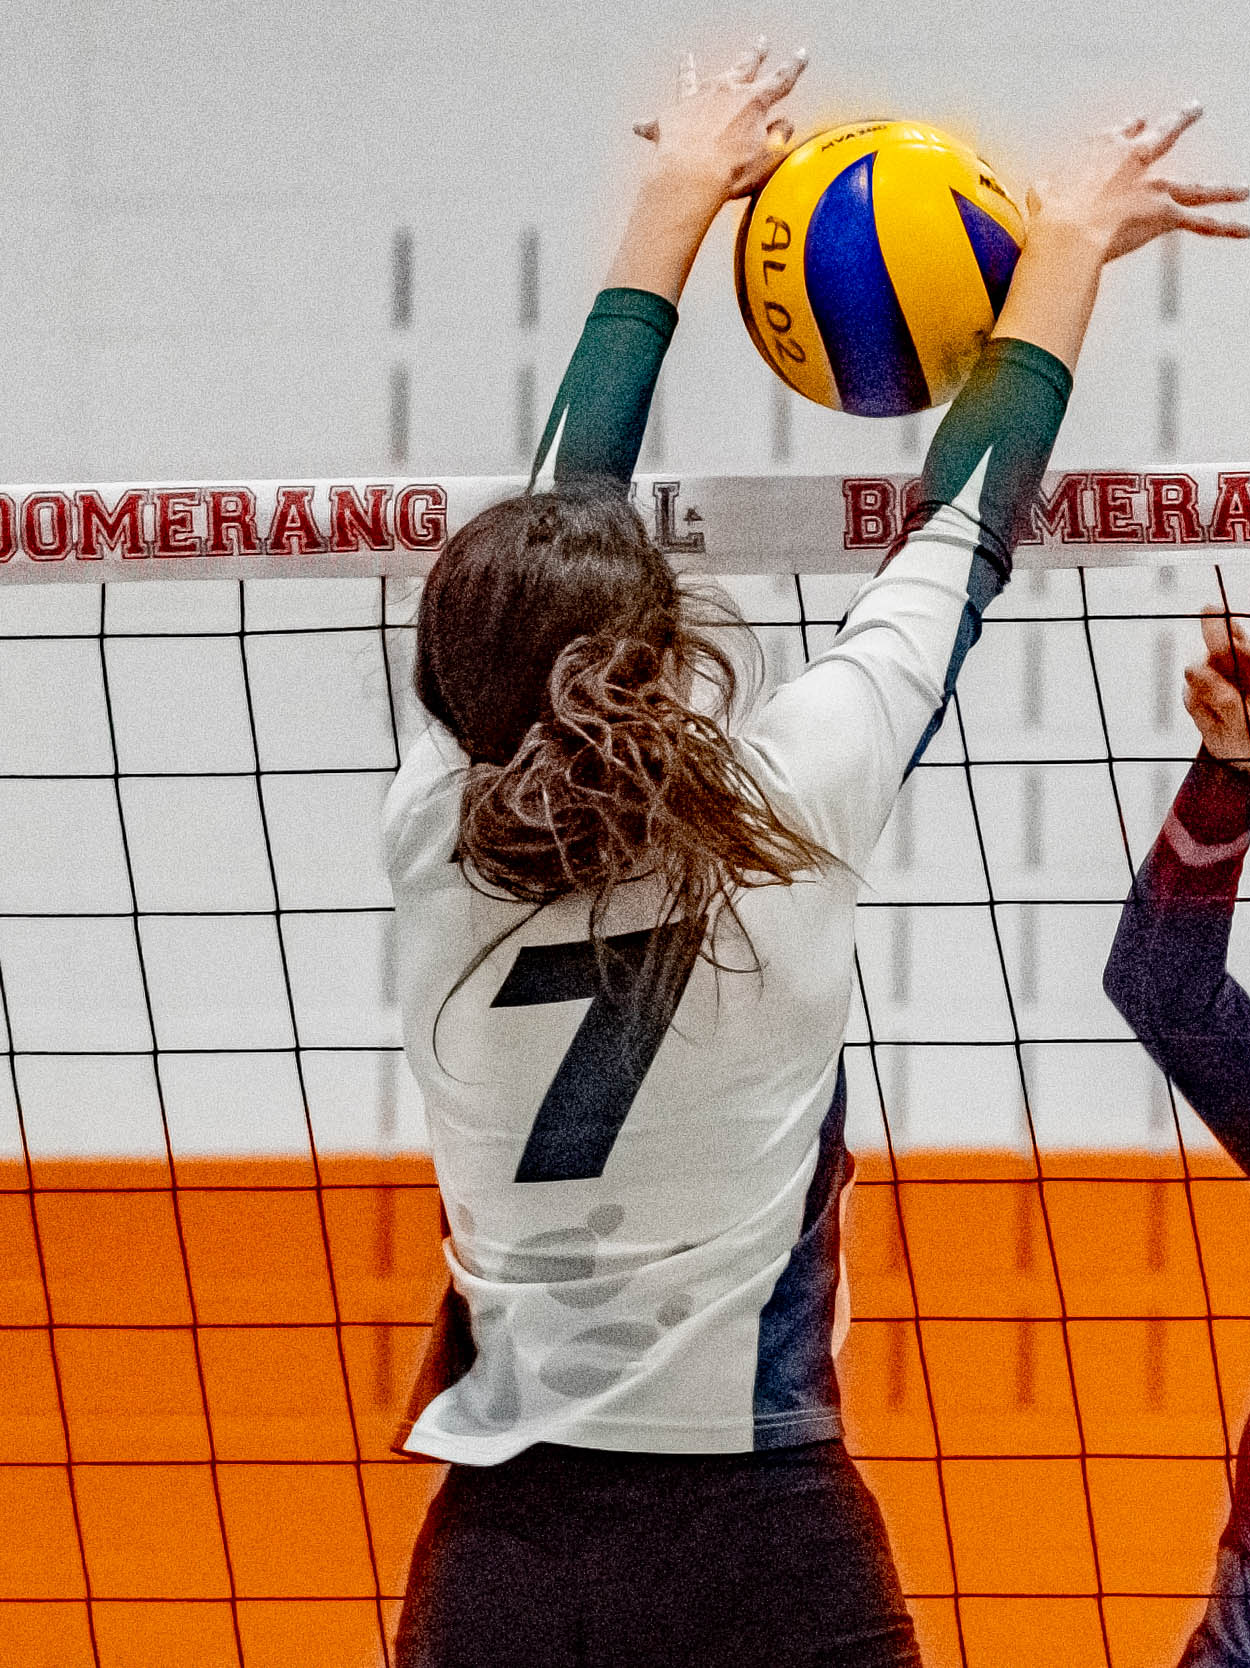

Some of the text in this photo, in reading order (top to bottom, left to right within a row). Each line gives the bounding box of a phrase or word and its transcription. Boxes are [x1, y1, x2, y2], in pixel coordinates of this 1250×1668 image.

[760, 214, 793, 286] AL
[629, 481, 706, 554] L
[489, 912, 710, 1184] 7
